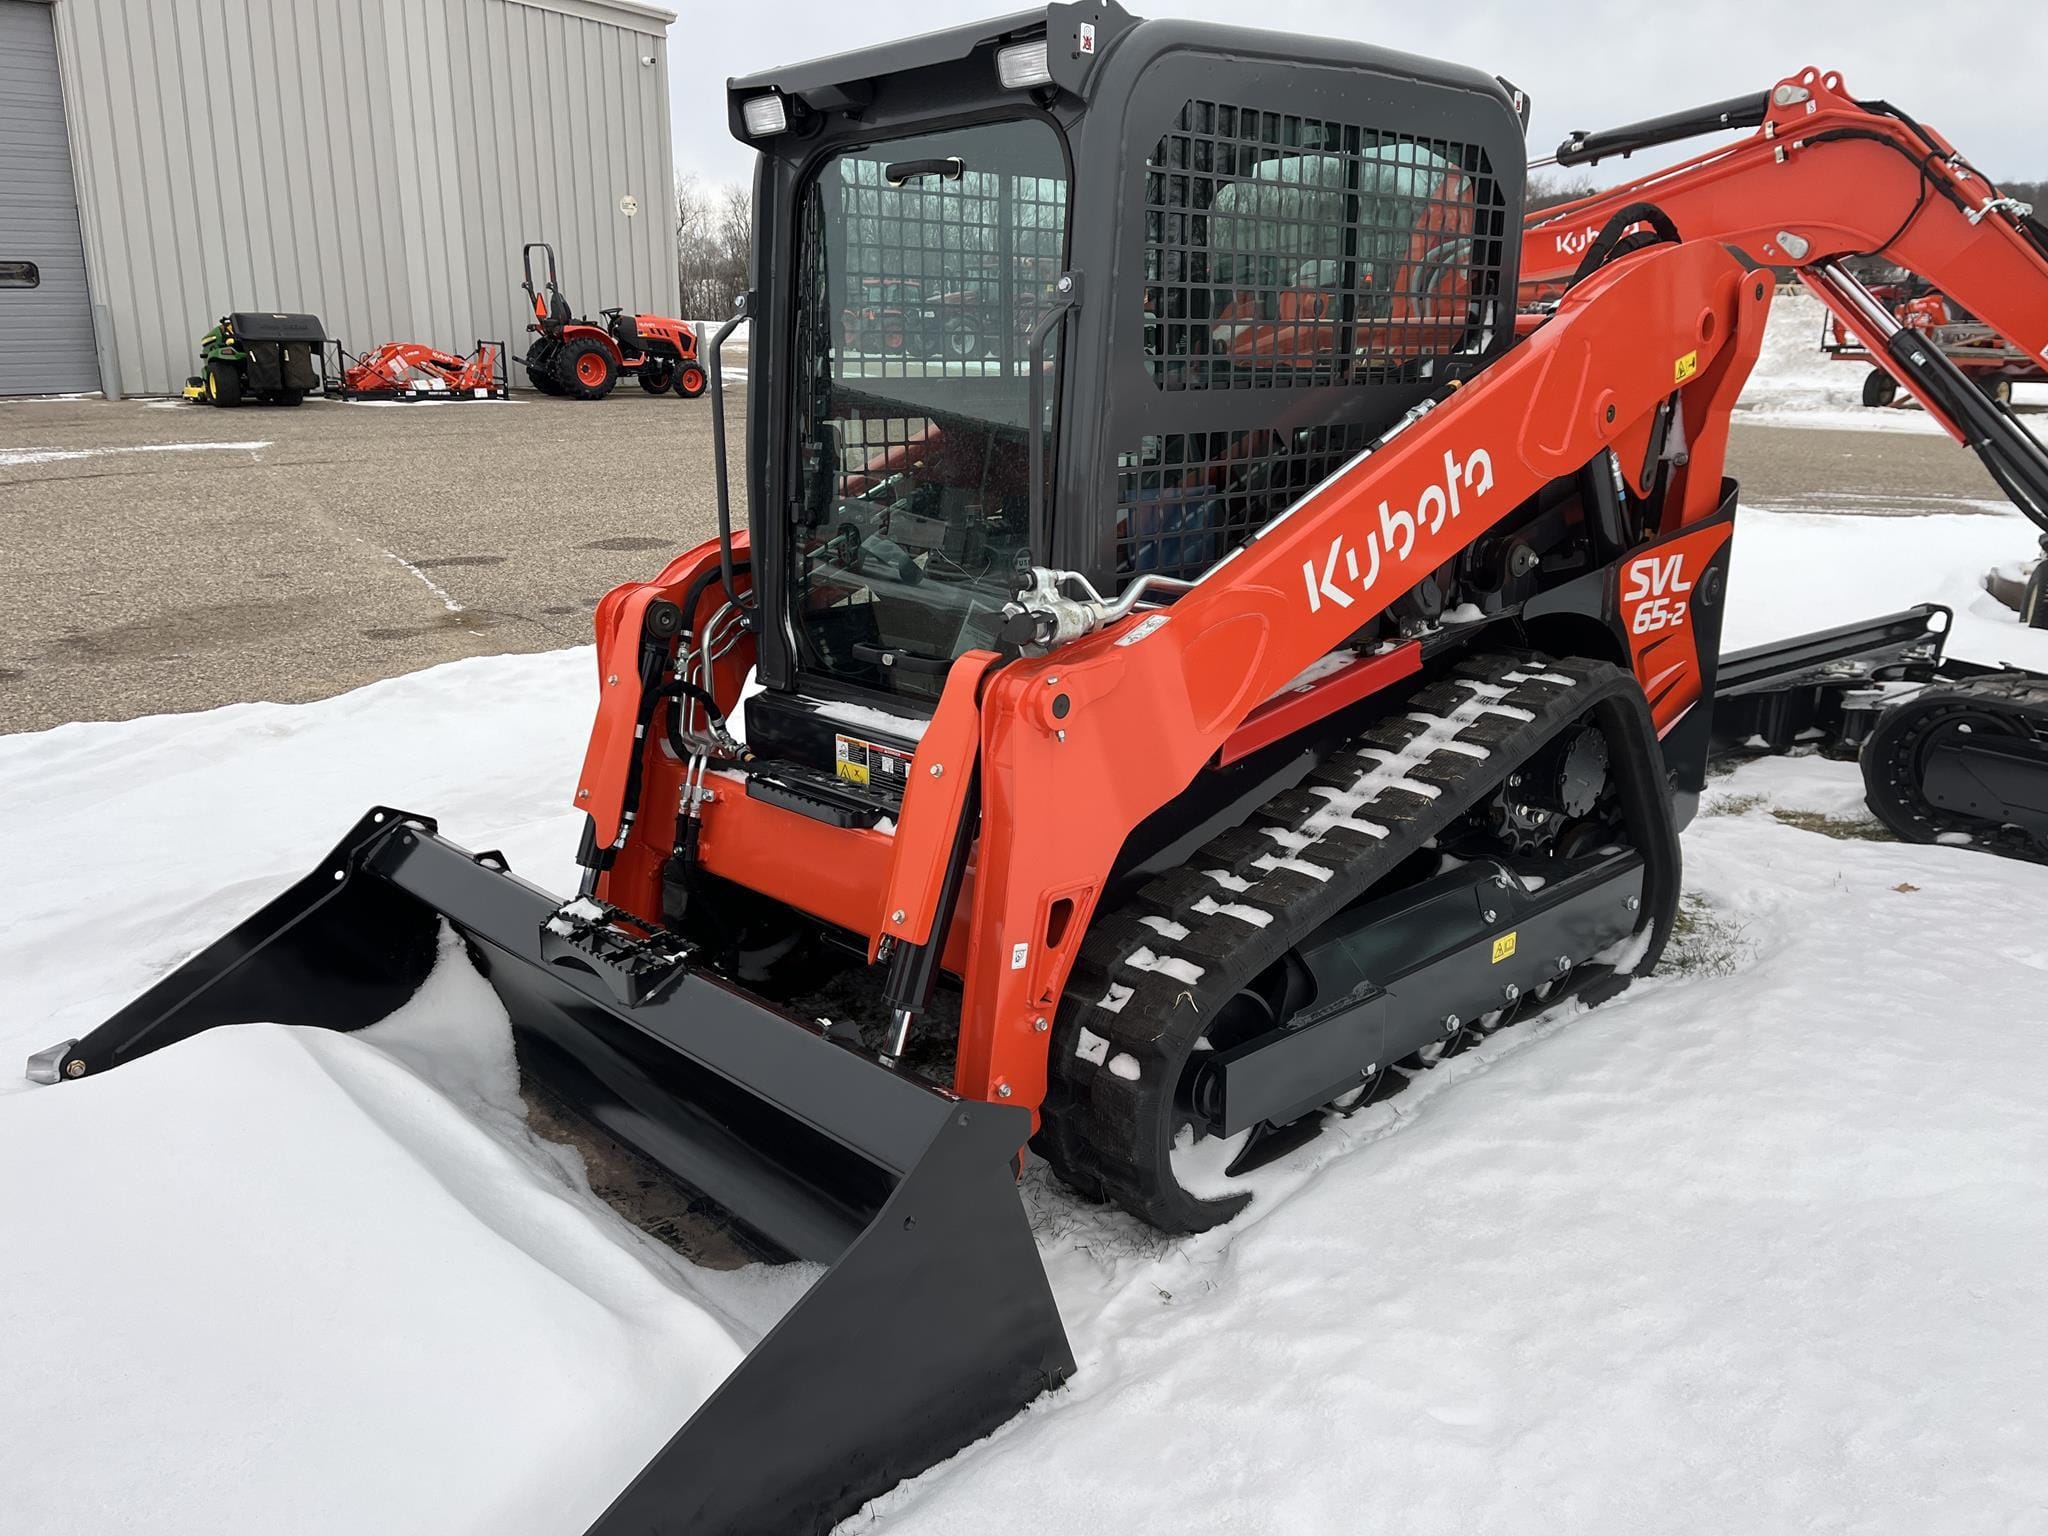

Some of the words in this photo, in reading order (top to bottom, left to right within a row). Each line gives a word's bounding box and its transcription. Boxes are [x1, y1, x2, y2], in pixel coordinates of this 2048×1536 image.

[1303, 448, 1494, 613] Kubota
[1625, 554, 1692, 601] SVL
[1634, 598, 1686, 634] 65-2
